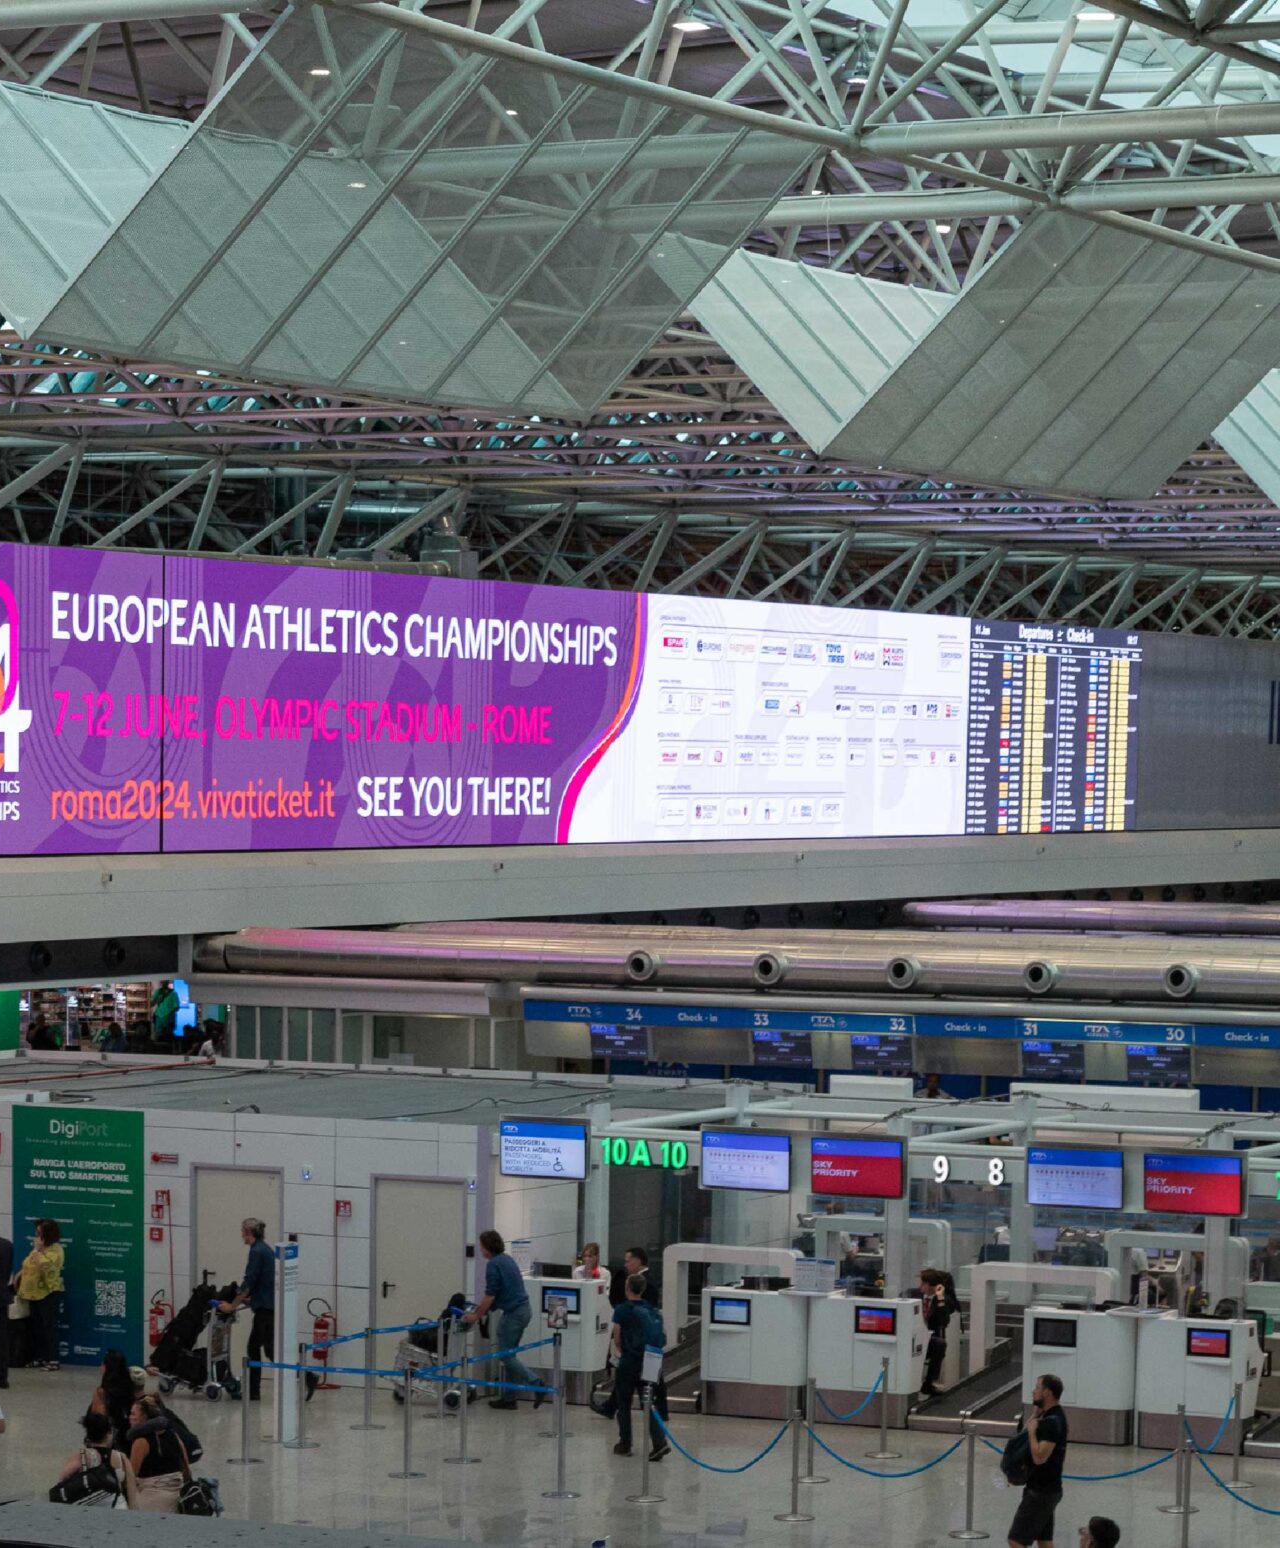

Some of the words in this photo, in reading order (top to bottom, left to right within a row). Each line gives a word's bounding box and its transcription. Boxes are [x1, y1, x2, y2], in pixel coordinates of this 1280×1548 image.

[51, 591, 236, 648] EUROPEAN
[242, 604, 399, 656] ATHLETICS
[404, 613, 618, 667] CHAMPIONSHIPS
[1019, 624, 1054, 642] Departures
[1066, 628, 1094, 643] Check-in
[53, 691, 114, 738] 7-12
[119, 693, 208, 748] JUNE,
[215, 694, 339, 742] OLYMPIC
[345, 699, 461, 743] STADIUM
[481, 704, 553, 745] ROME
[50, 776, 336, 822] roma2024.vivaticket.it
[356, 776, 404, 818] SEE
[409, 776, 463, 818] YOU
[468, 776, 551, 816] THERE!
[626, 1008, 643, 1021] 34
[677, 1012, 703, 1022] Check
[710, 1013, 718, 1023] in
[753, 1013, 769, 1026] 33
[889, 1017, 906, 1031] 32
[944, 1022, 971, 1032] Check
[979, 1023, 987, 1033] in
[1023, 1023, 1038, 1036] 31
[1165, 1028, 1185, 1042] 30
[1224, 1032, 1251, 1042] Check
[1260, 1033, 1269, 1043] in
[49, 1119, 109, 1138] DigiPort
[505, 1145, 531, 1153] RIDOTTA
[33, 1158, 66, 1169] NAVIGA
[813, 1160, 832, 1169] SKY
[932, 1155, 950, 1183] 9
[30, 1170, 47, 1179] SUL
[48, 1171, 67, 1181] TUO
[68, 1172, 130, 1184] SMARTPHONE
[813, 1168, 858, 1178] PRIORITY
[988, 1158, 1005, 1186] 8
[1146, 1177, 1166, 1185] SKY
[1146, 1185, 1194, 1195] PRIORITY
